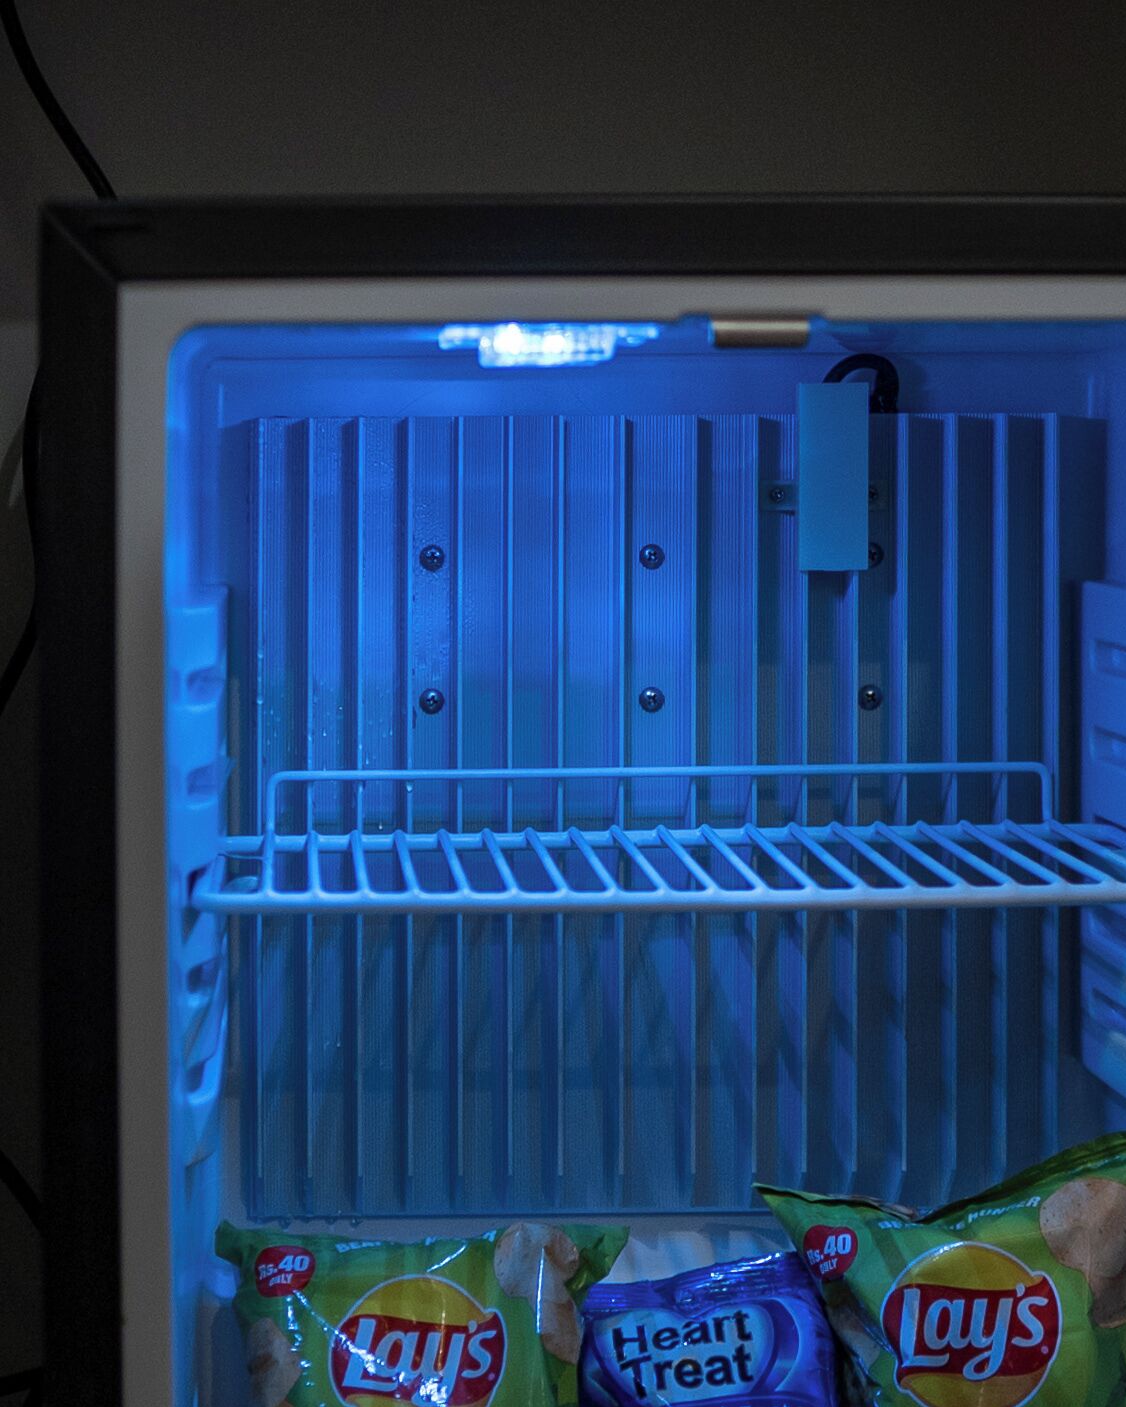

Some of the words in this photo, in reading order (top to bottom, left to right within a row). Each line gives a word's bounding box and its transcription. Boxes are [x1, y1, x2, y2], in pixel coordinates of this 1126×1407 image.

[612, 1309, 752, 1362] Heart
[901, 1282, 1050, 1381] Lay's
[619, 1343, 754, 1400] Treat
